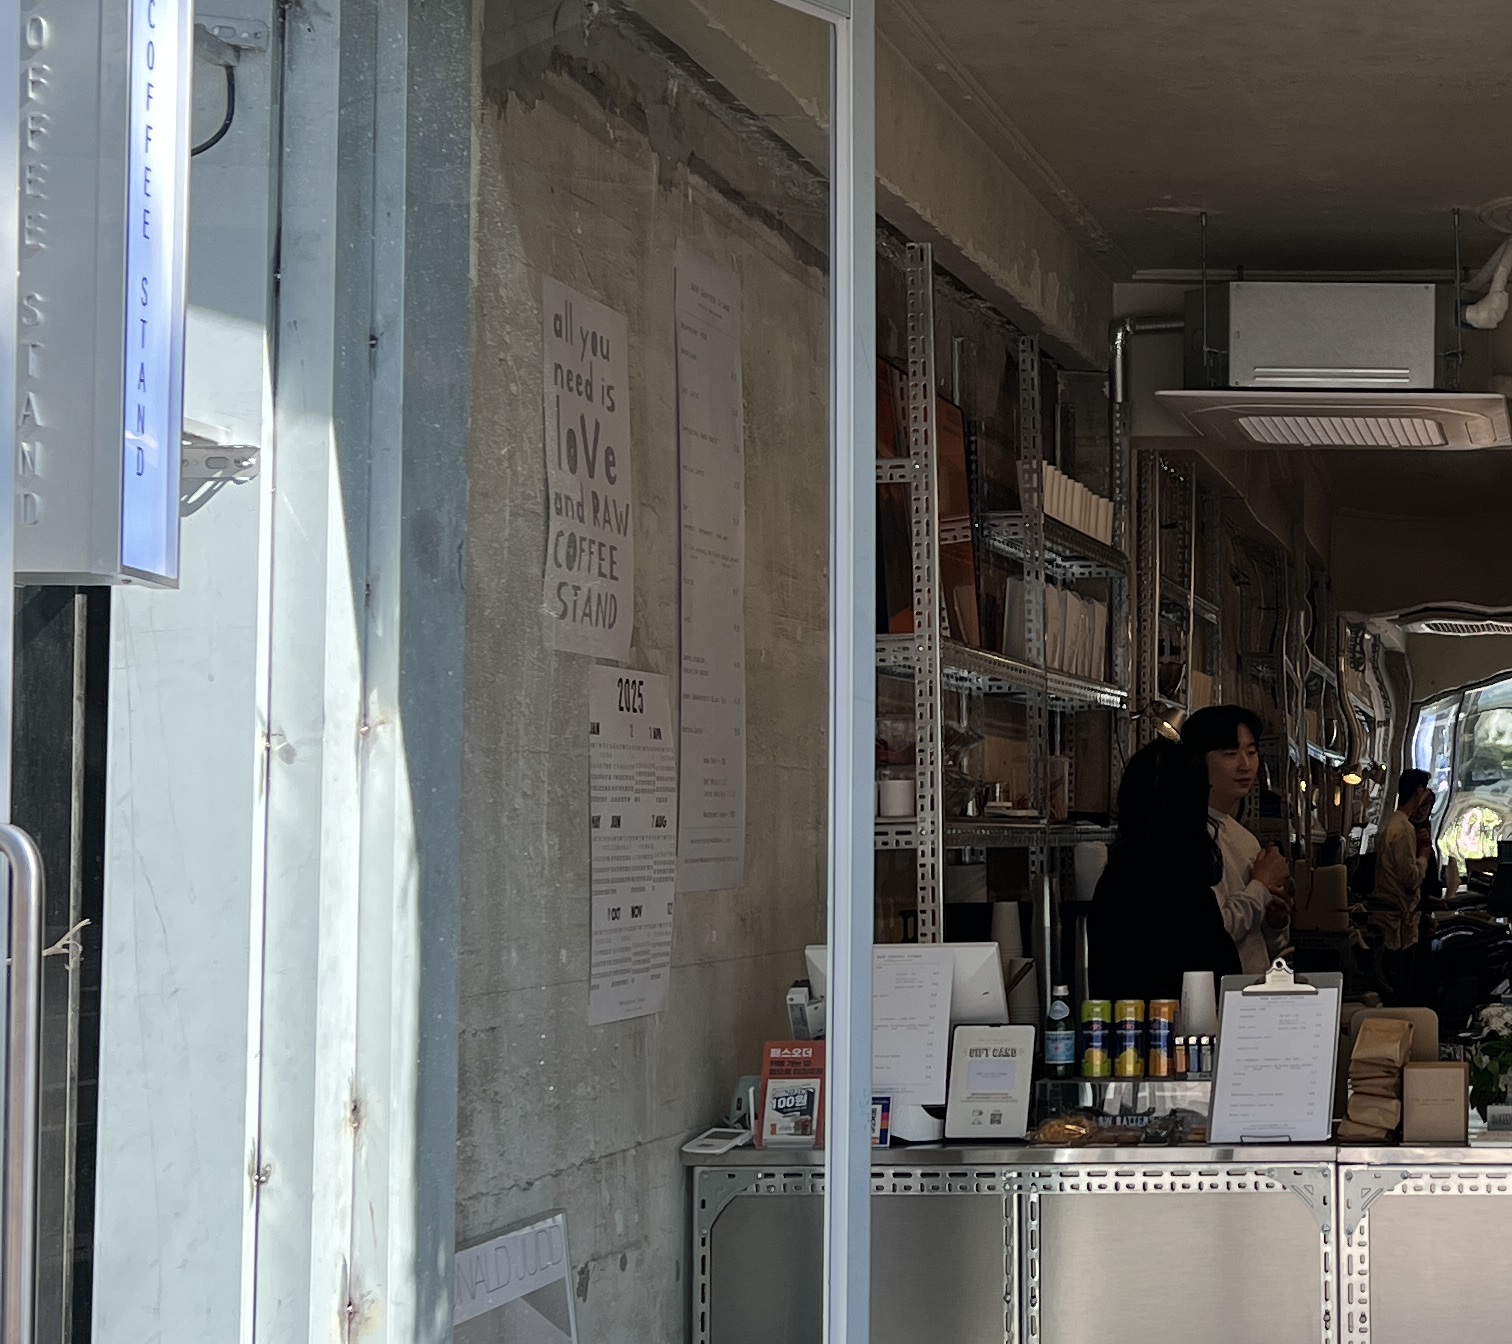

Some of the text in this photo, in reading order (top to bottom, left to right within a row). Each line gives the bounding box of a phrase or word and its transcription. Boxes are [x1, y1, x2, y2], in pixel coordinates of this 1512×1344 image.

[553, 299, 610, 362] all you
[135, 275, 149, 477] STAND
[553, 360, 616, 413] need is
[14, 291, 47, 526] STAND
[554, 481, 630, 537] and RAW
[553, 529, 619, 582] COFFEE
[556, 581, 618, 630] STAND
[617, 677, 644, 714] 2025
